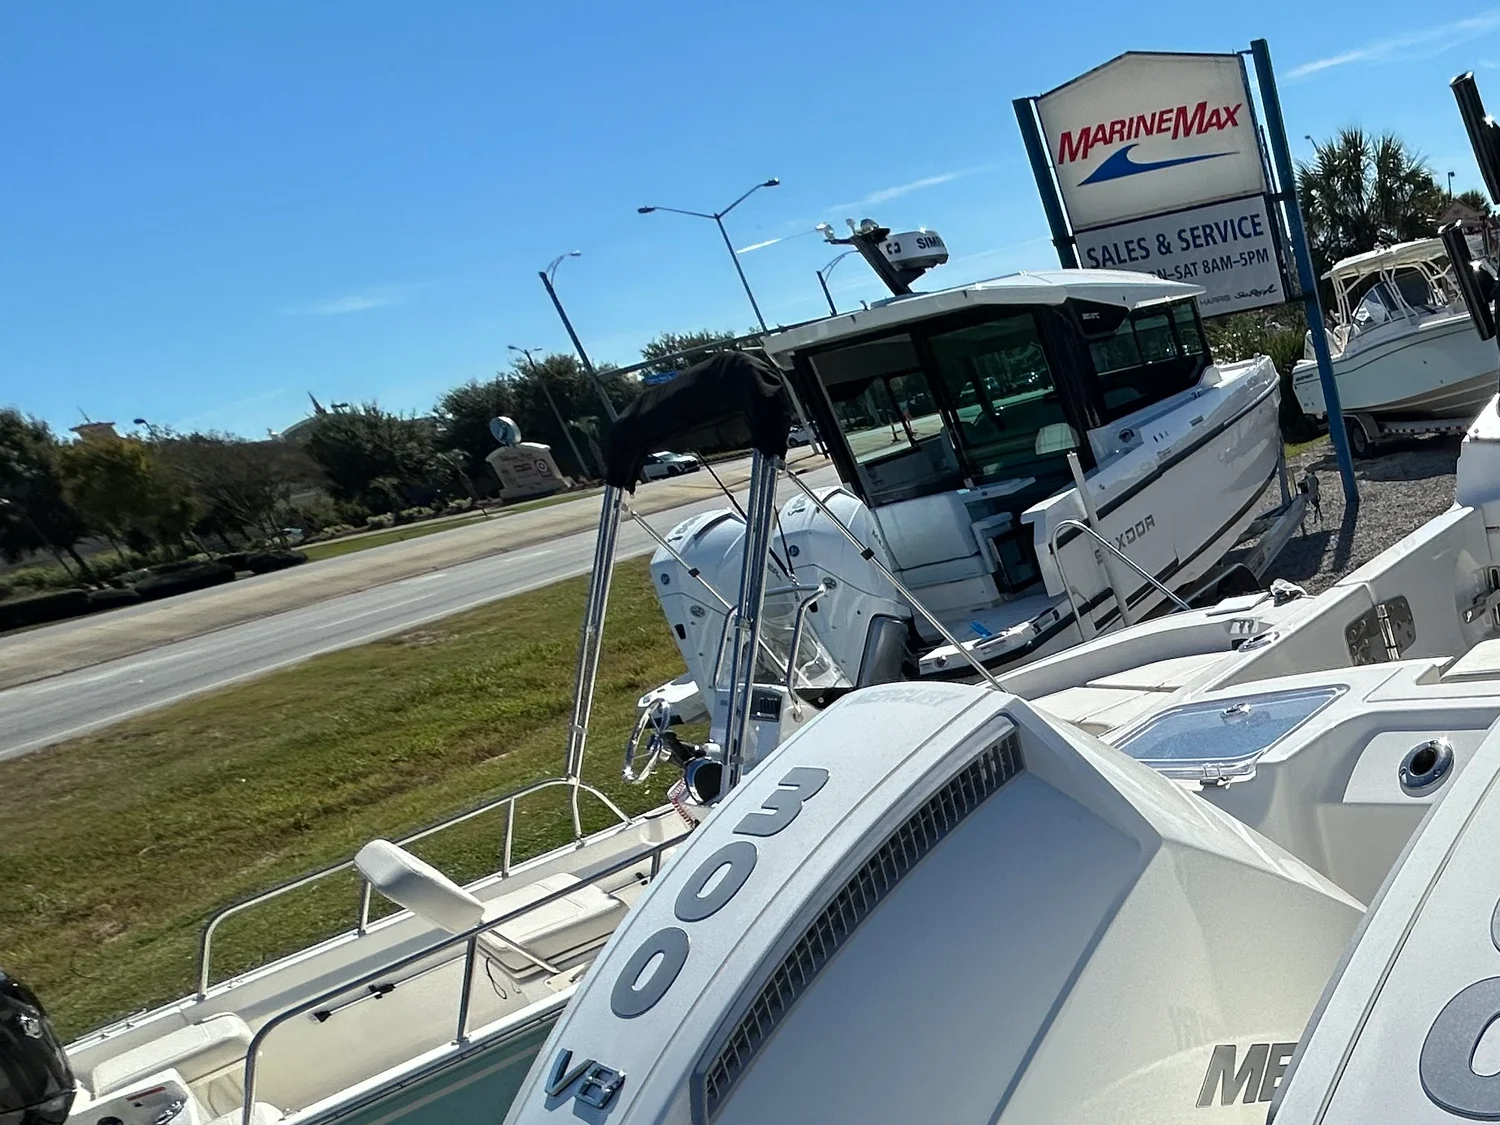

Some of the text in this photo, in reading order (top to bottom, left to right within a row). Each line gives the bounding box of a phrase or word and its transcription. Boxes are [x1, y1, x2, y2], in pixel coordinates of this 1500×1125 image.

[1086, 213, 1265, 269] SALES & SERVICE
[610, 766, 831, 1020] 300
[544, 1047, 627, 1109] V8
